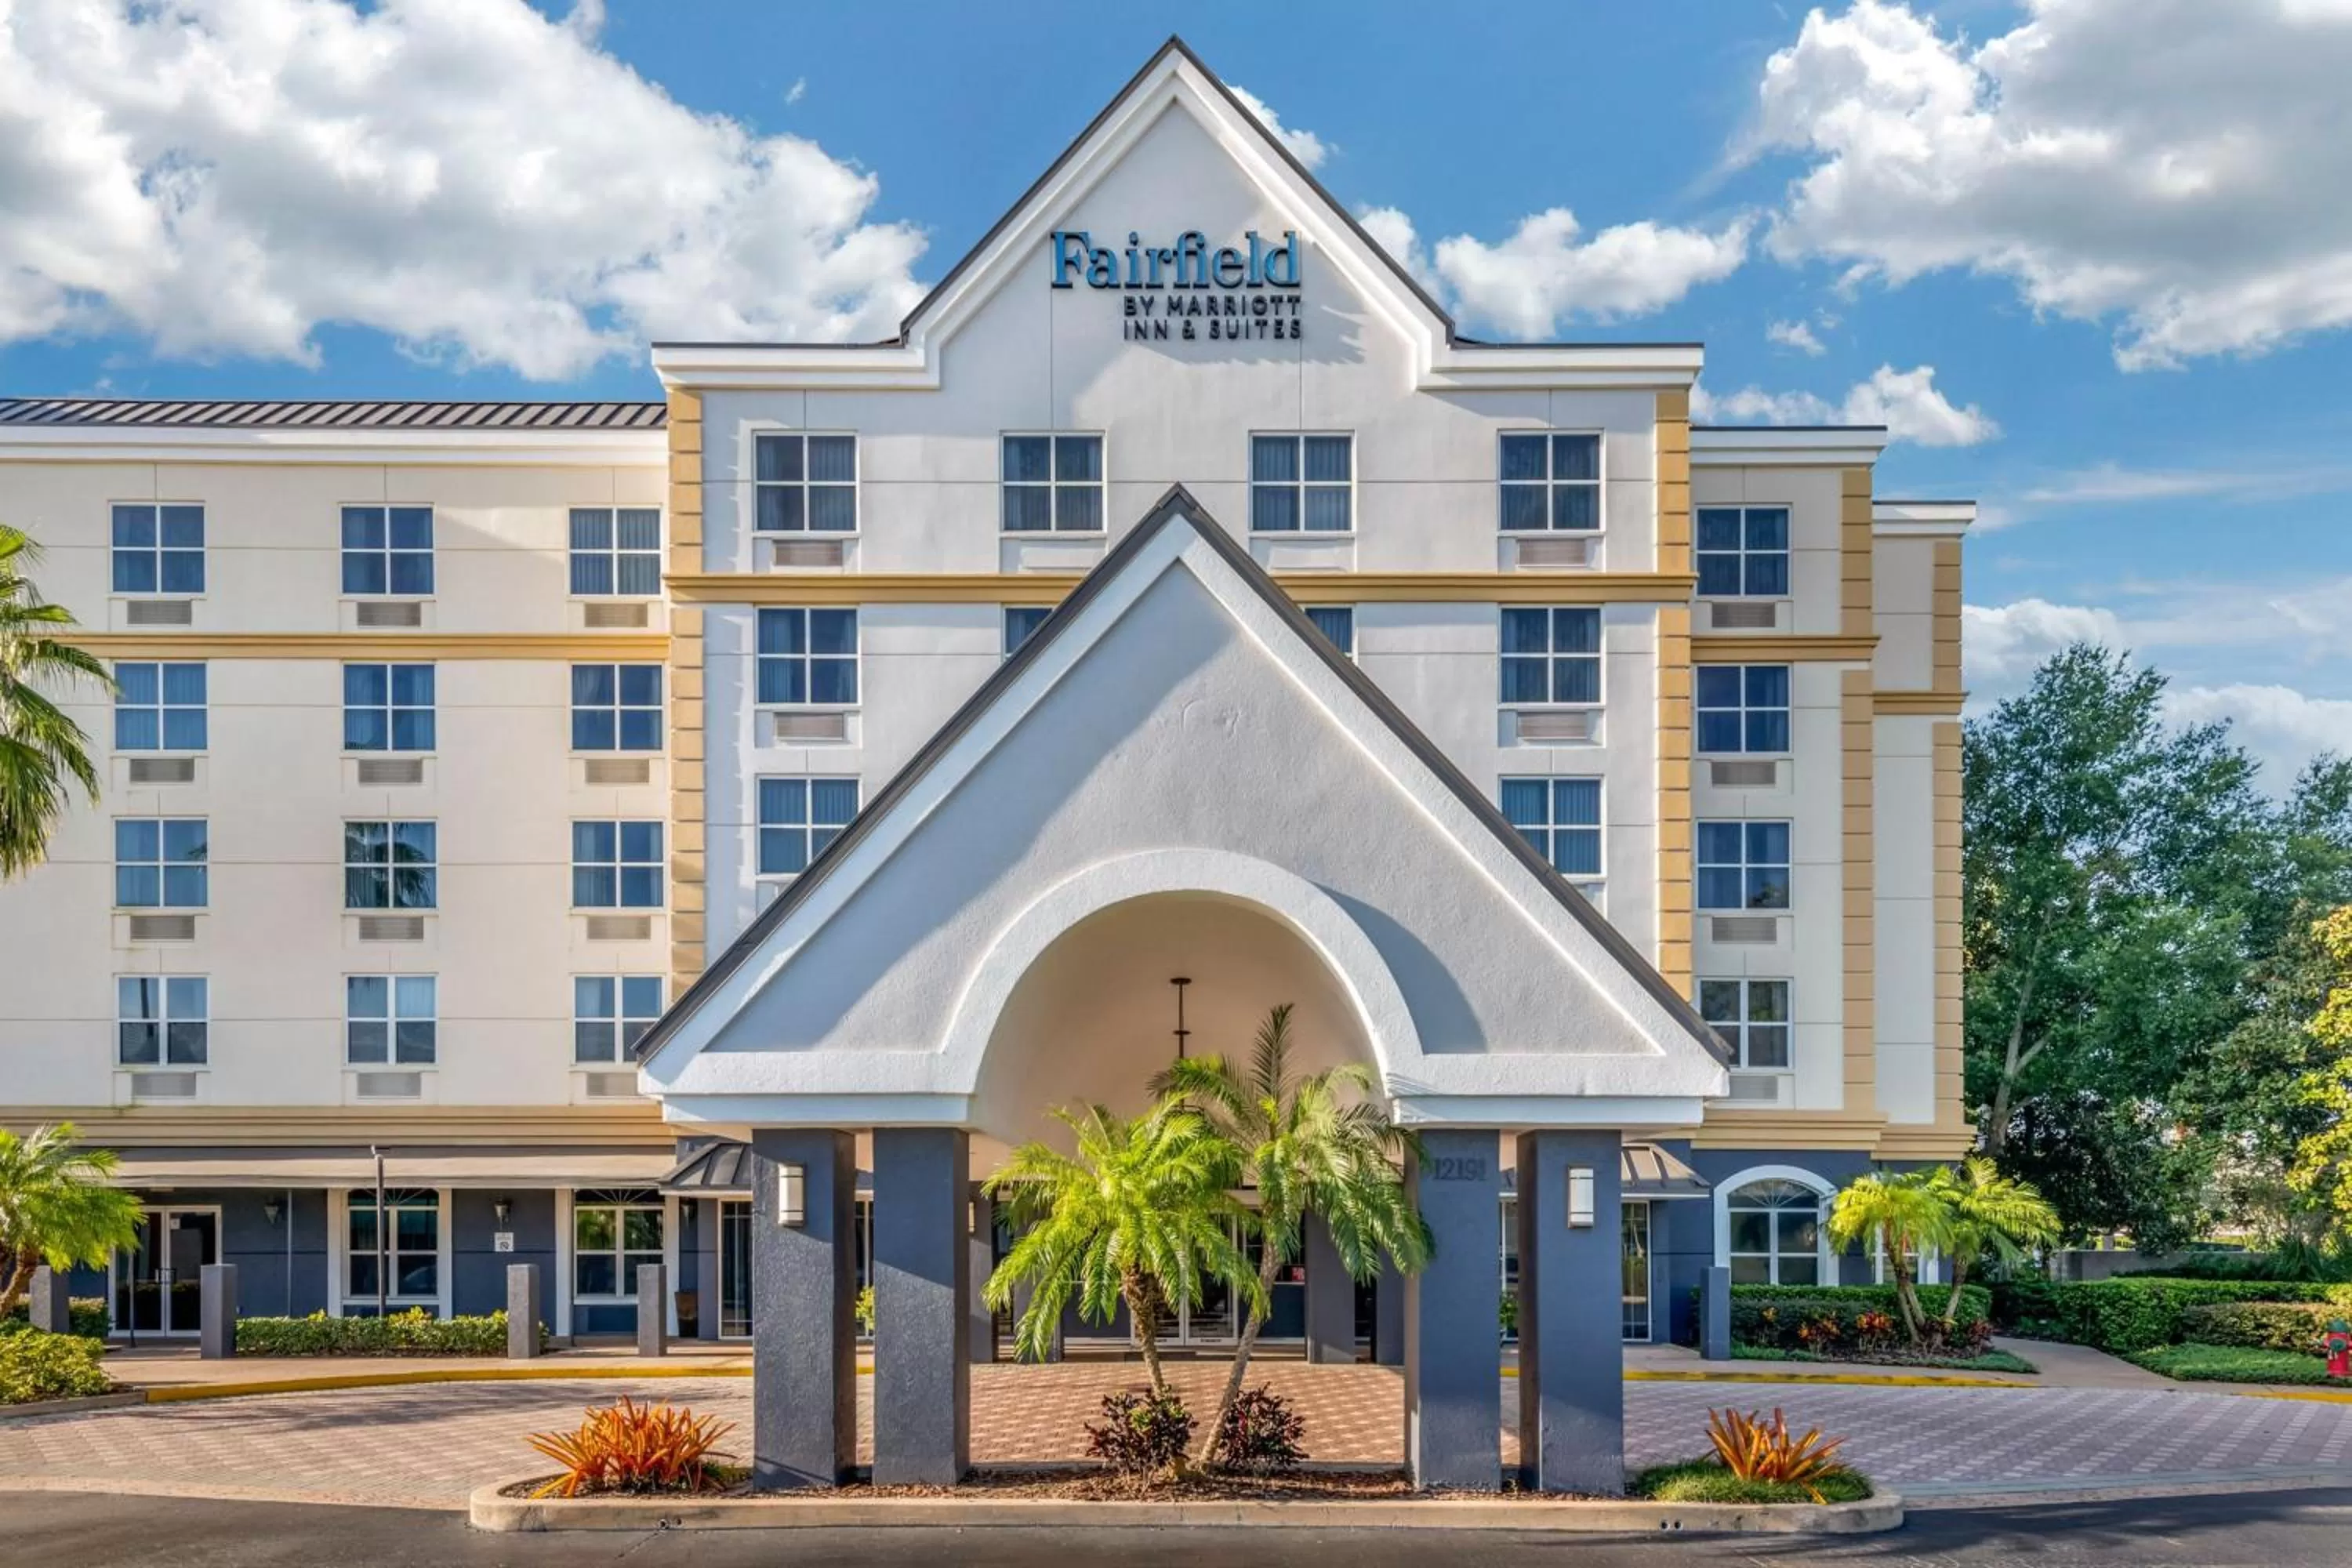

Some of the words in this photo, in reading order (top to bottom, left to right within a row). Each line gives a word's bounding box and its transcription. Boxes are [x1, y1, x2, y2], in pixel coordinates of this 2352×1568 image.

[1051, 230, 1301, 289] Fairfield
[1123, 295, 1155, 316] BY
[1167, 295, 1301, 316] MARRIOTT
[1123, 319, 1167, 339] INN
[1181, 319, 1196, 339] &
[1208, 319, 1301, 339] SUITES
